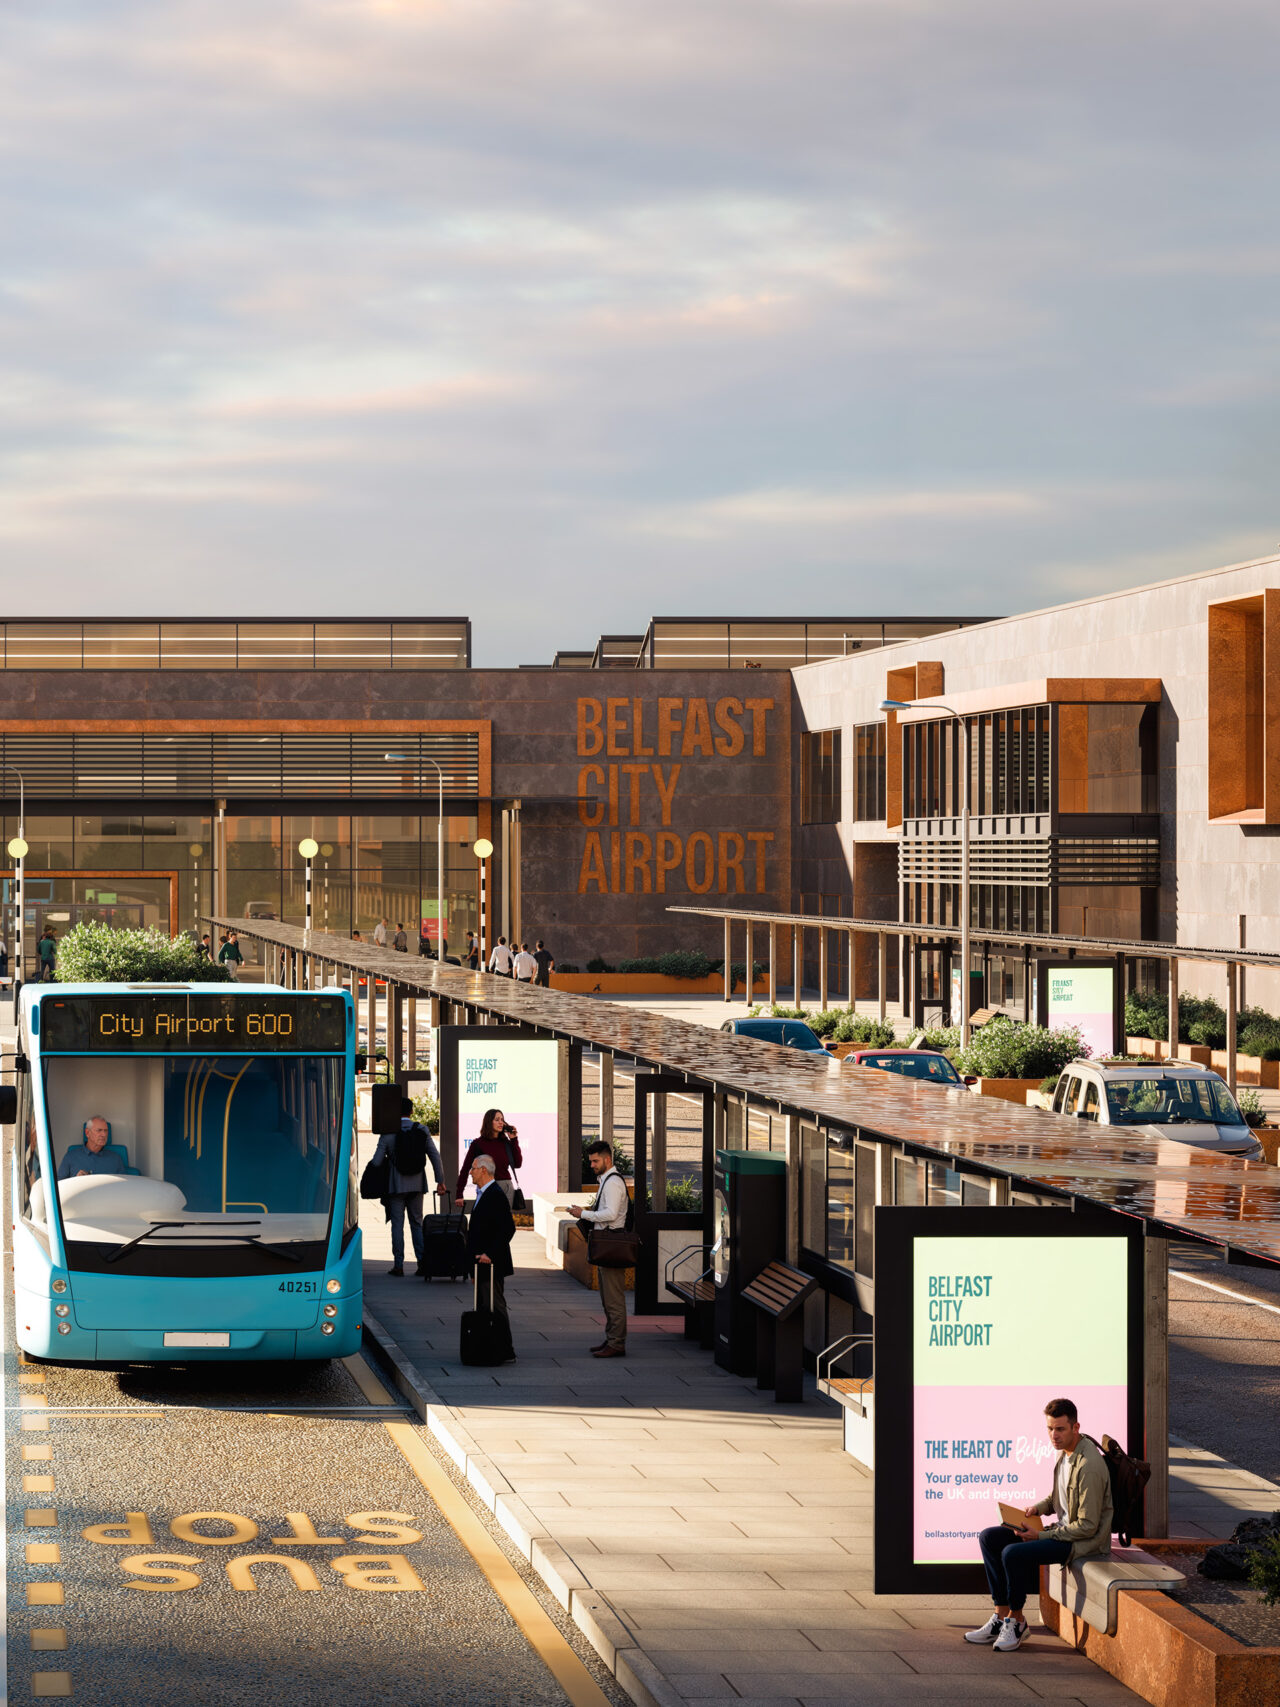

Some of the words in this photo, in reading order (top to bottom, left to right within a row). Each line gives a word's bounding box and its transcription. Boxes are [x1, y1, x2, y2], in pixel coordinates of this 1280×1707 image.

[577, 697, 774, 757] BELFAST
[577, 763, 682, 826] CITY
[577, 831, 774, 894] AIRPORT
[99, 1013, 144, 1037] City
[155, 1013, 235, 1036] Airport
[246, 1013, 293, 1035] 600
[466, 1070, 483, 1082] CITY
[466, 1082, 498, 1094] AIRPORT
[278, 1281, 317, 1293] 40251
[928, 1275, 993, 1297] BELFAST
[928, 1299, 963, 1322] CITY
[928, 1323, 993, 1347] AIRPORT
[924, 1440, 949, 1459] THE
[951, 1440, 994, 1459] HEART
[996, 1440, 1013, 1459] OF
[925, 1472, 952, 1484] Your
[954, 1472, 1004, 1486] gateway
[1007, 1472, 1019, 1483] to
[925, 1489, 944, 1500] the
[947, 1488, 965, 1500] UK
[968, 1488, 990, 1500] and
[993, 1488, 1036, 1503] beyond
[81, 1511, 423, 1545] STOP
[119, 1553, 427, 1592] BUS
